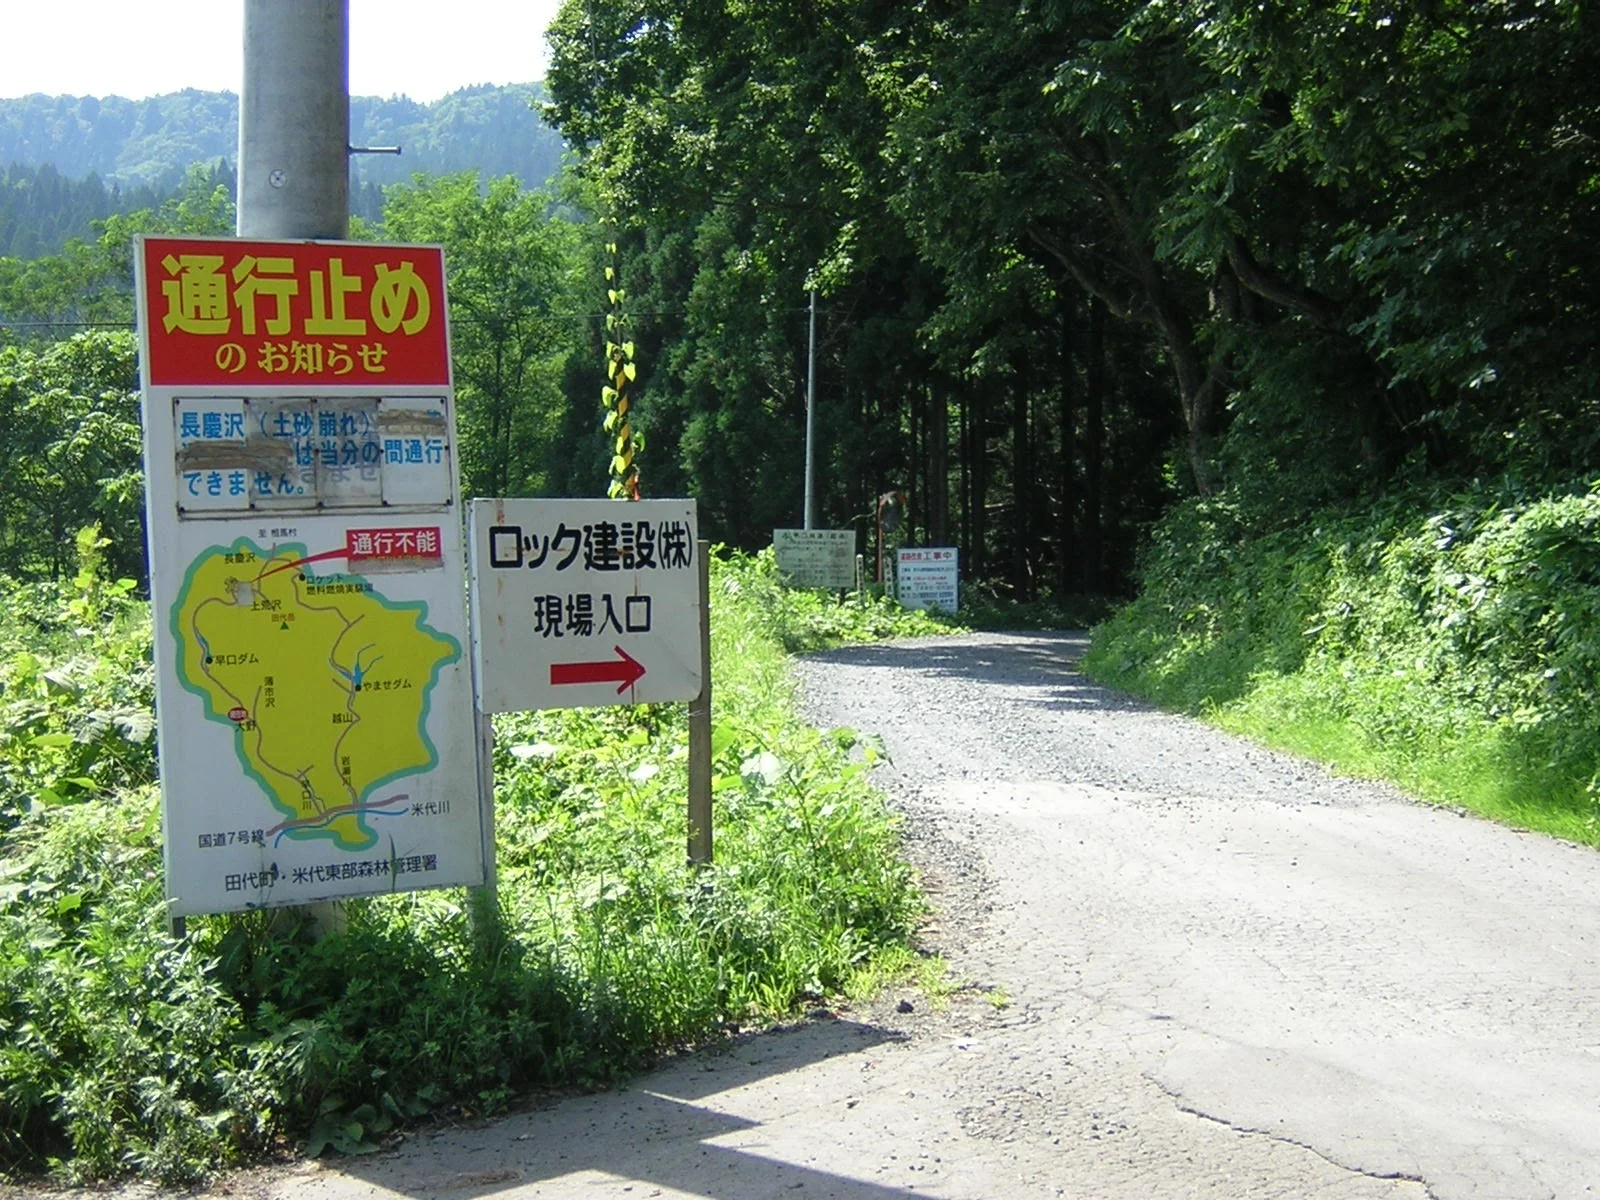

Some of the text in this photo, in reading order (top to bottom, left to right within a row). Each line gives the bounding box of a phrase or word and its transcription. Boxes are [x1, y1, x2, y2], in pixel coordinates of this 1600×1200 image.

[161, 255, 430, 336] 通行止め
[215, 341, 388, 375] のお知らせ
[351, 530, 438, 555] 通行不能
[533, 593, 652, 638] 現場入口
[411, 800, 451, 817] 米代川
[198, 829, 266, 849] 国道7号線
